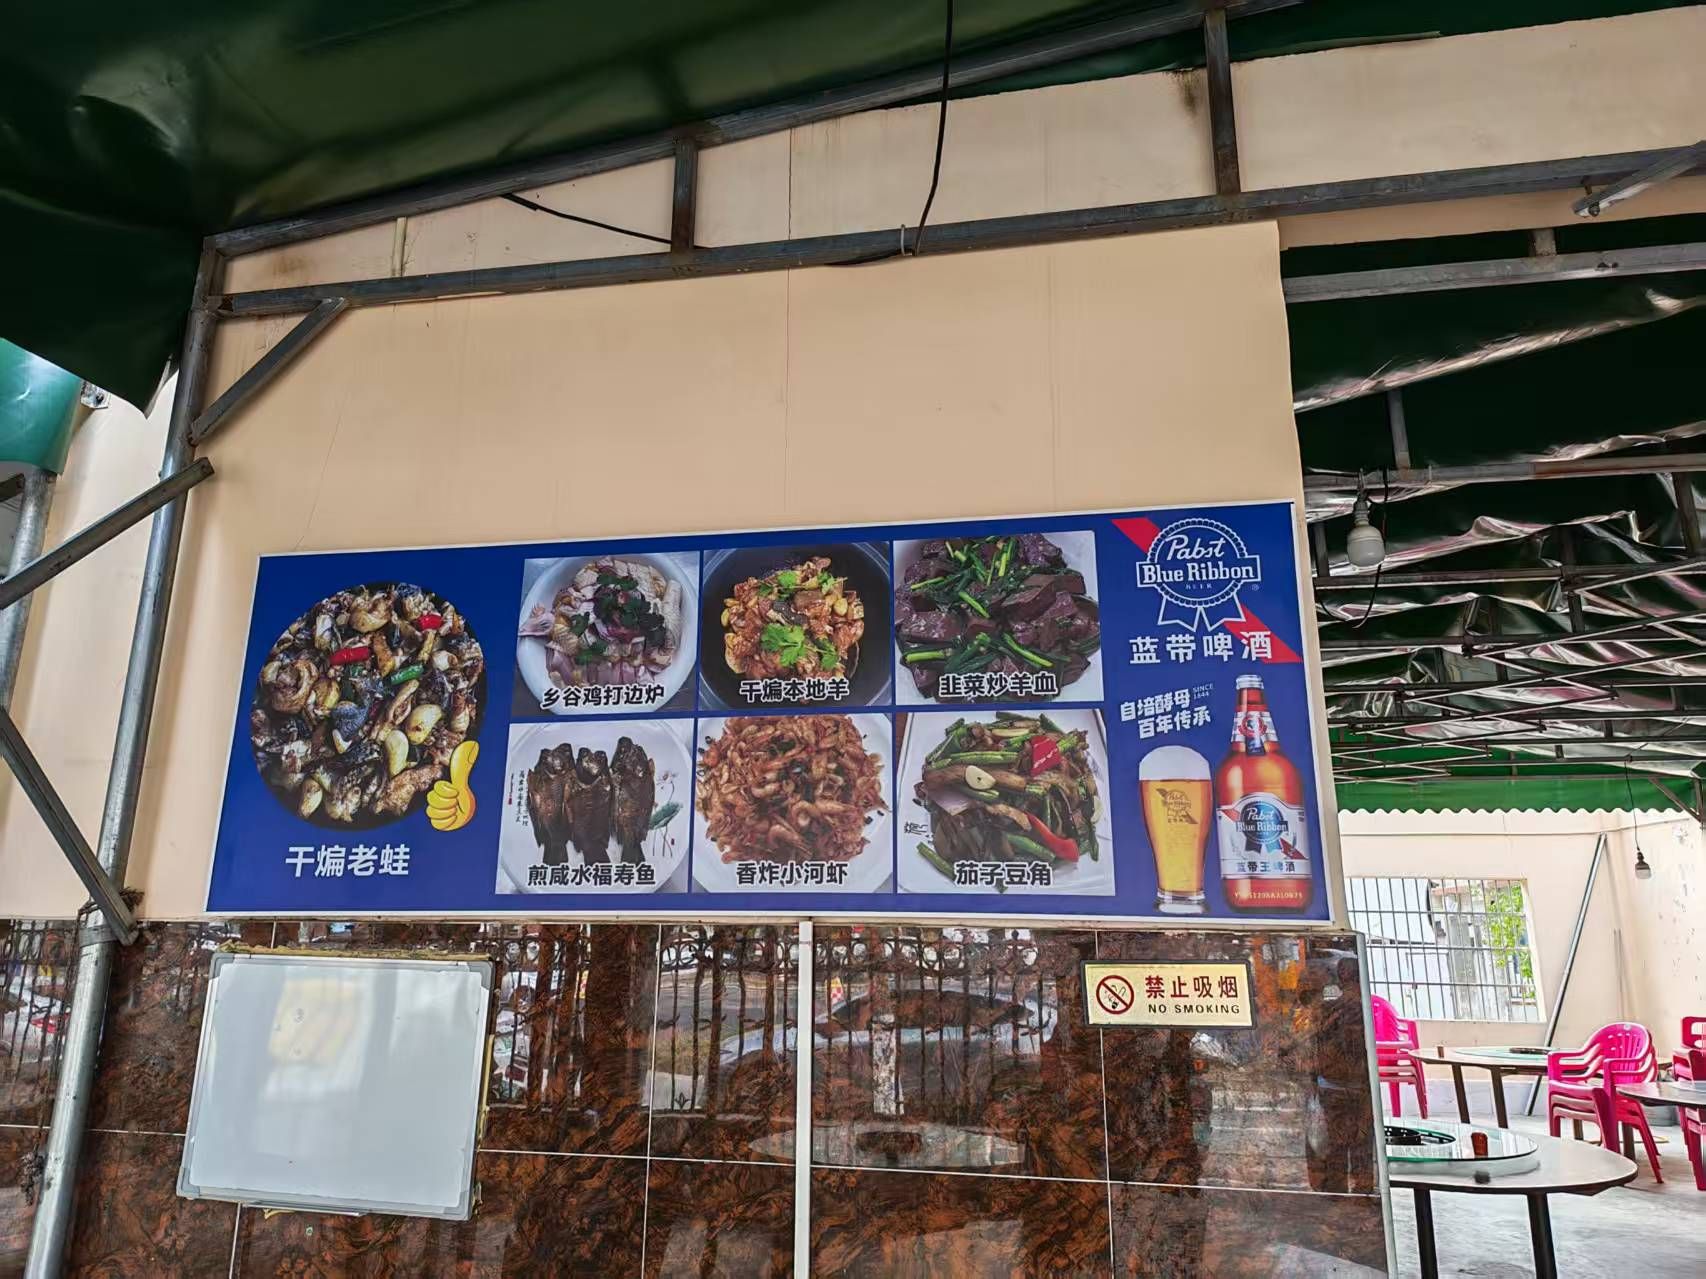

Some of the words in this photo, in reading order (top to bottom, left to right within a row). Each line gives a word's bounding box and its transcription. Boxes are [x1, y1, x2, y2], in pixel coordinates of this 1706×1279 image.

[1165, 534, 1225, 561] Pabst
[1142, 564, 1184, 584] Blue
[1187, 561, 1255, 582] Ribbon
[1129, 631, 1272, 664] 蓝带啤酒
[541, 684, 665, 708] 乡谷鸡打边炉
[740, 678, 850, 703] 干煸本地羊
[939, 672, 1058, 698] 韭菜炒羊血
[1120, 688, 1190, 721] 自培酵母
[1138, 706, 1211, 739] 百年传承
[285, 844, 410, 878] 干煸老蛙
[527, 862, 656, 887] 煎咸水福寿鱼
[736, 862, 849, 886] 香炸小河虾
[954, 861, 1053, 887] 茄子豆角
[1145, 975, 1238, 999] 禁止吸烟
[1148, 1004, 1167, 1013] NO
[1175, 1004, 1240, 1014] SMOKING
